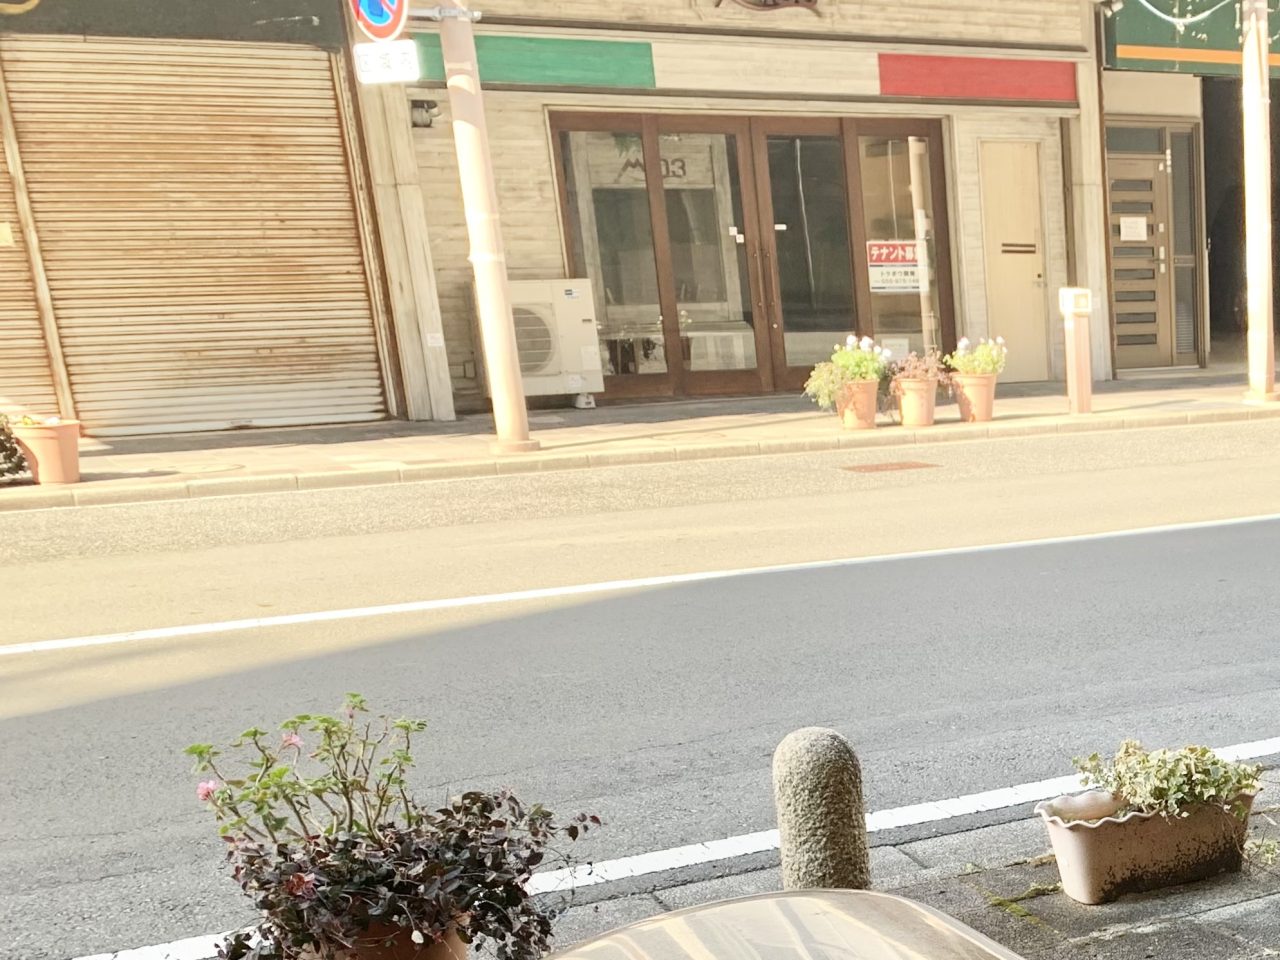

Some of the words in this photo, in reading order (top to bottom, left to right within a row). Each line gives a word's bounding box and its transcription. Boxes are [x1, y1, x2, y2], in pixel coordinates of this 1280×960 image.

[871, 246, 917, 260] テナント募
